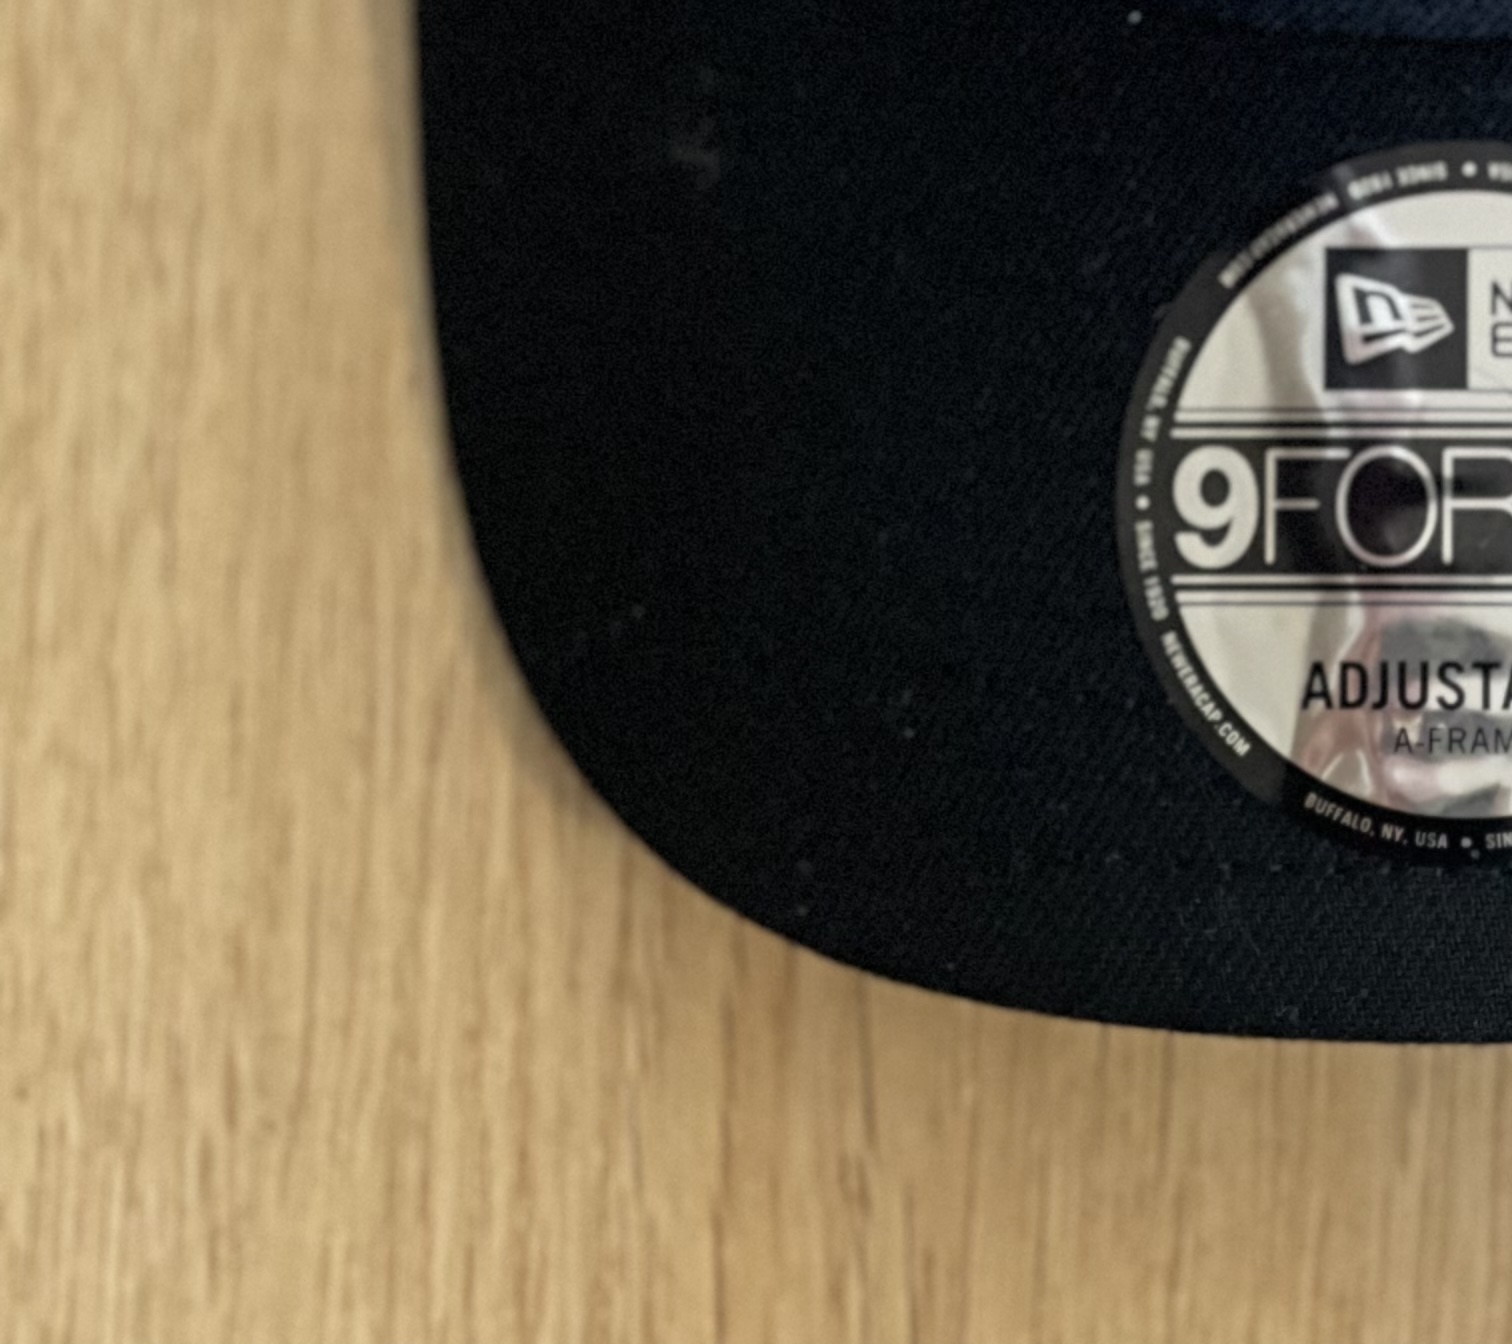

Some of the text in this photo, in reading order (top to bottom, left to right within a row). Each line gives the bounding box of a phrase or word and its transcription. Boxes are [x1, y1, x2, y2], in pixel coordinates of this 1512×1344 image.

[1160, 629, 1252, 757] NEWERACAP.COM
[1304, 792, 1376, 837] BUFFALO,
[1415, 833, 1449, 850] USA
